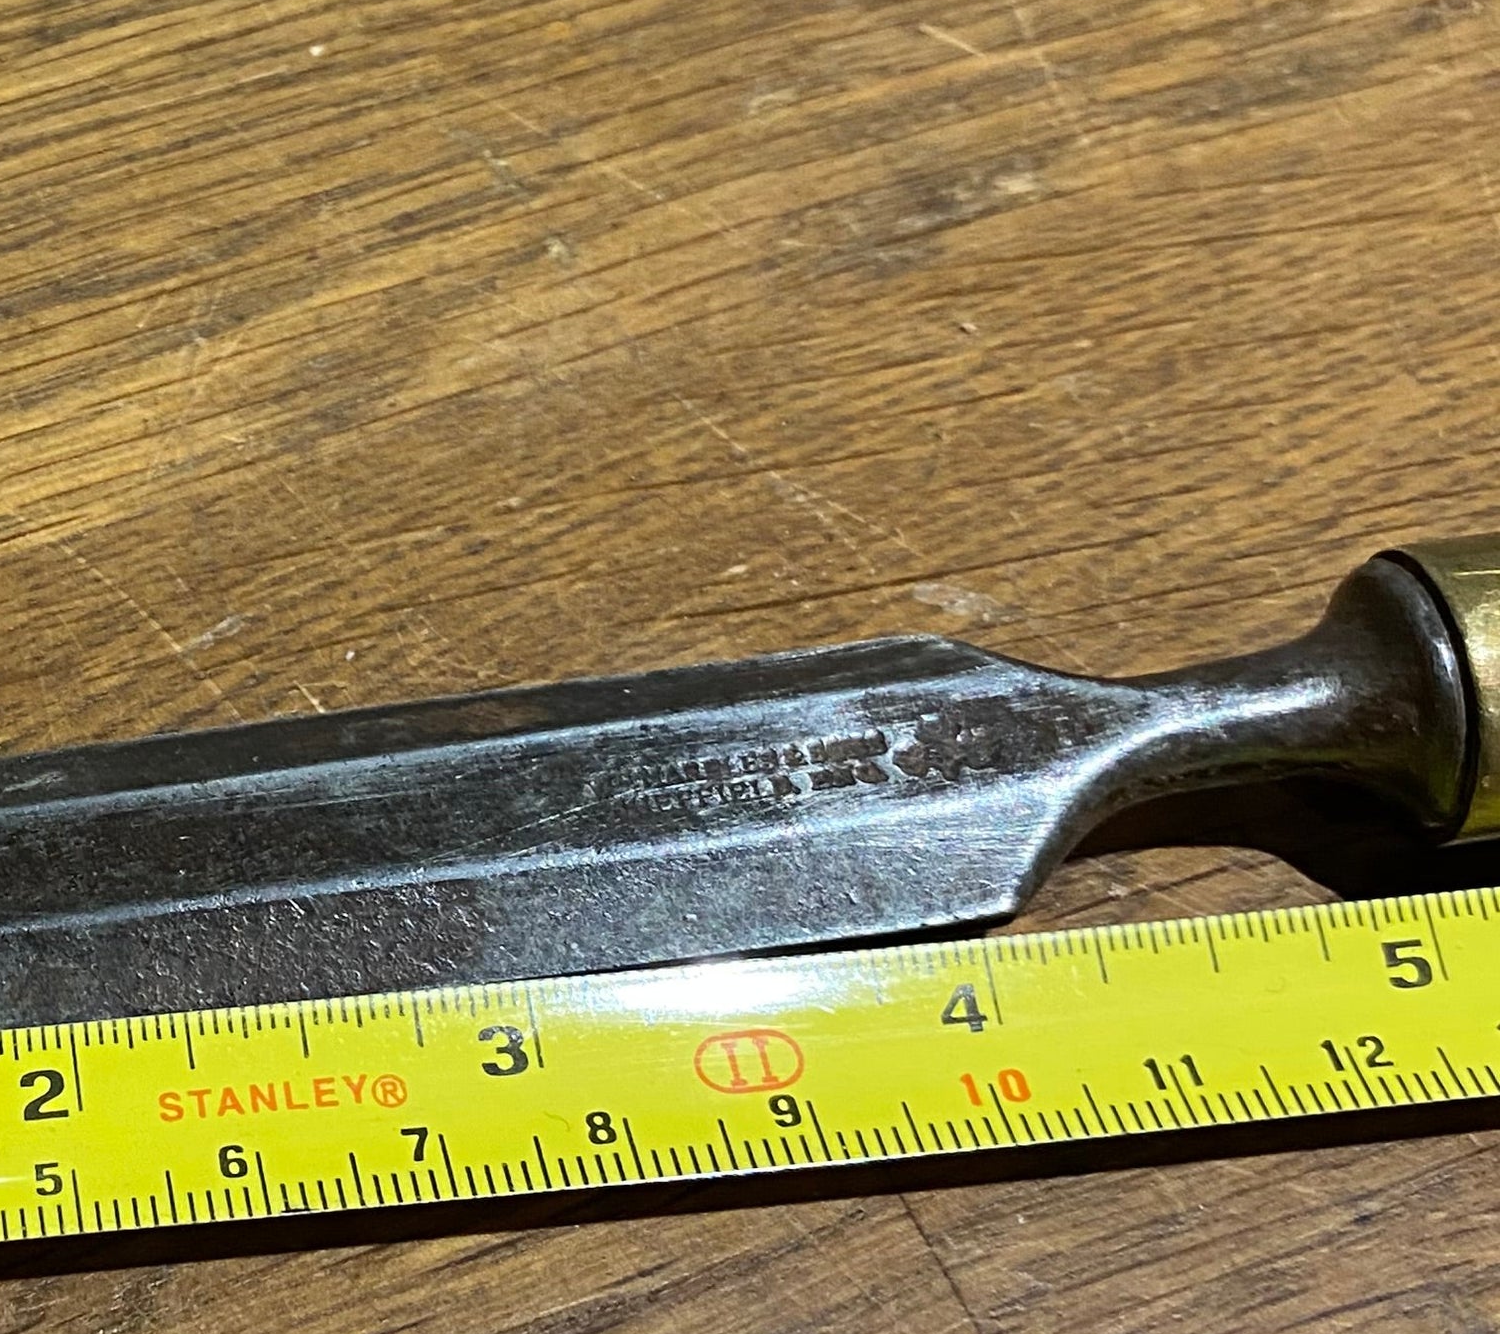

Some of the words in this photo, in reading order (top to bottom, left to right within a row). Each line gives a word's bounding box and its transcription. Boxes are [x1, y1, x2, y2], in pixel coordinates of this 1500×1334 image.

[1381, 939, 1433, 988] 5
[941, 983, 988, 1033] 4
[478, 1025, 529, 1077] 3
[1320, 1035, 1394, 1072] 12
[960, 1068, 1031, 1106] 10
[1143, 1054, 1202, 1090] 11
[19, 1070, 69, 1121] 2
[768, 1094, 801, 1127] 9
[400, 1127, 429, 1162] 7
[586, 1111, 618, 1145] 8
[218, 1144, 248, 1178] 6
[33, 1163, 63, 1196] 5
